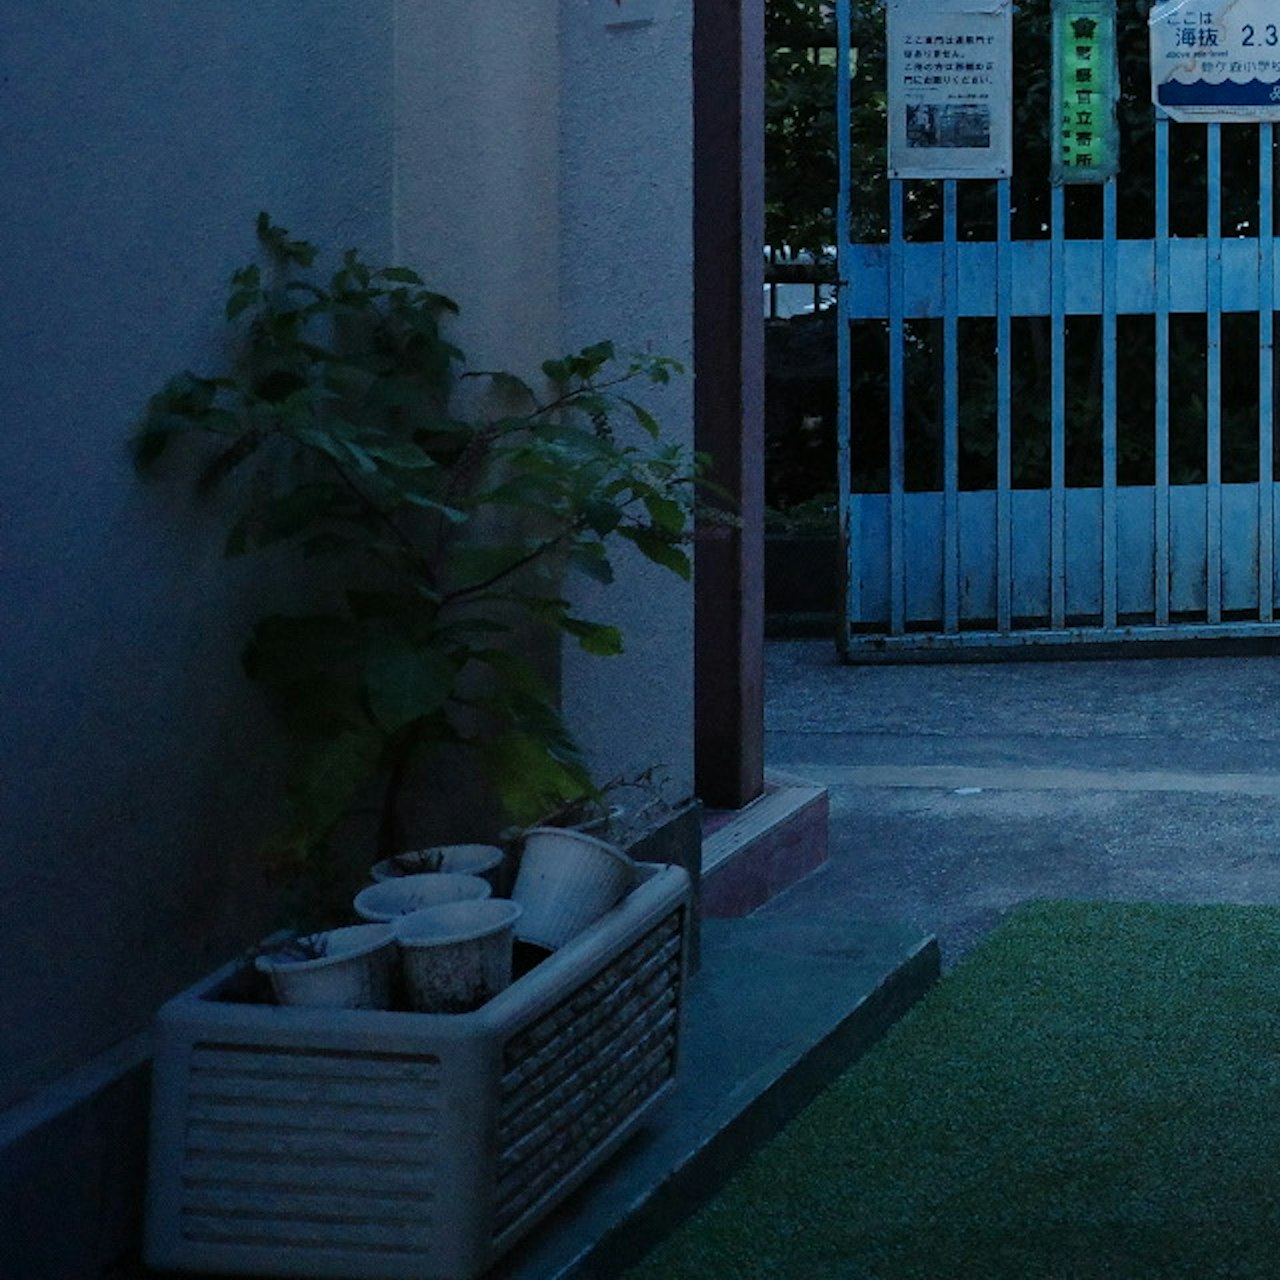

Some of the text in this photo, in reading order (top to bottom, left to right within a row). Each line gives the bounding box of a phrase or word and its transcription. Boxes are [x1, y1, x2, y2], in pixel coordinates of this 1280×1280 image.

[1167, 11, 1212, 25] ここは
[1175, 27, 1219, 48] 海抜
[1241, 24, 1278, 47] 2.3
[1075, 45, 1093, 167] 警察官立寄所
